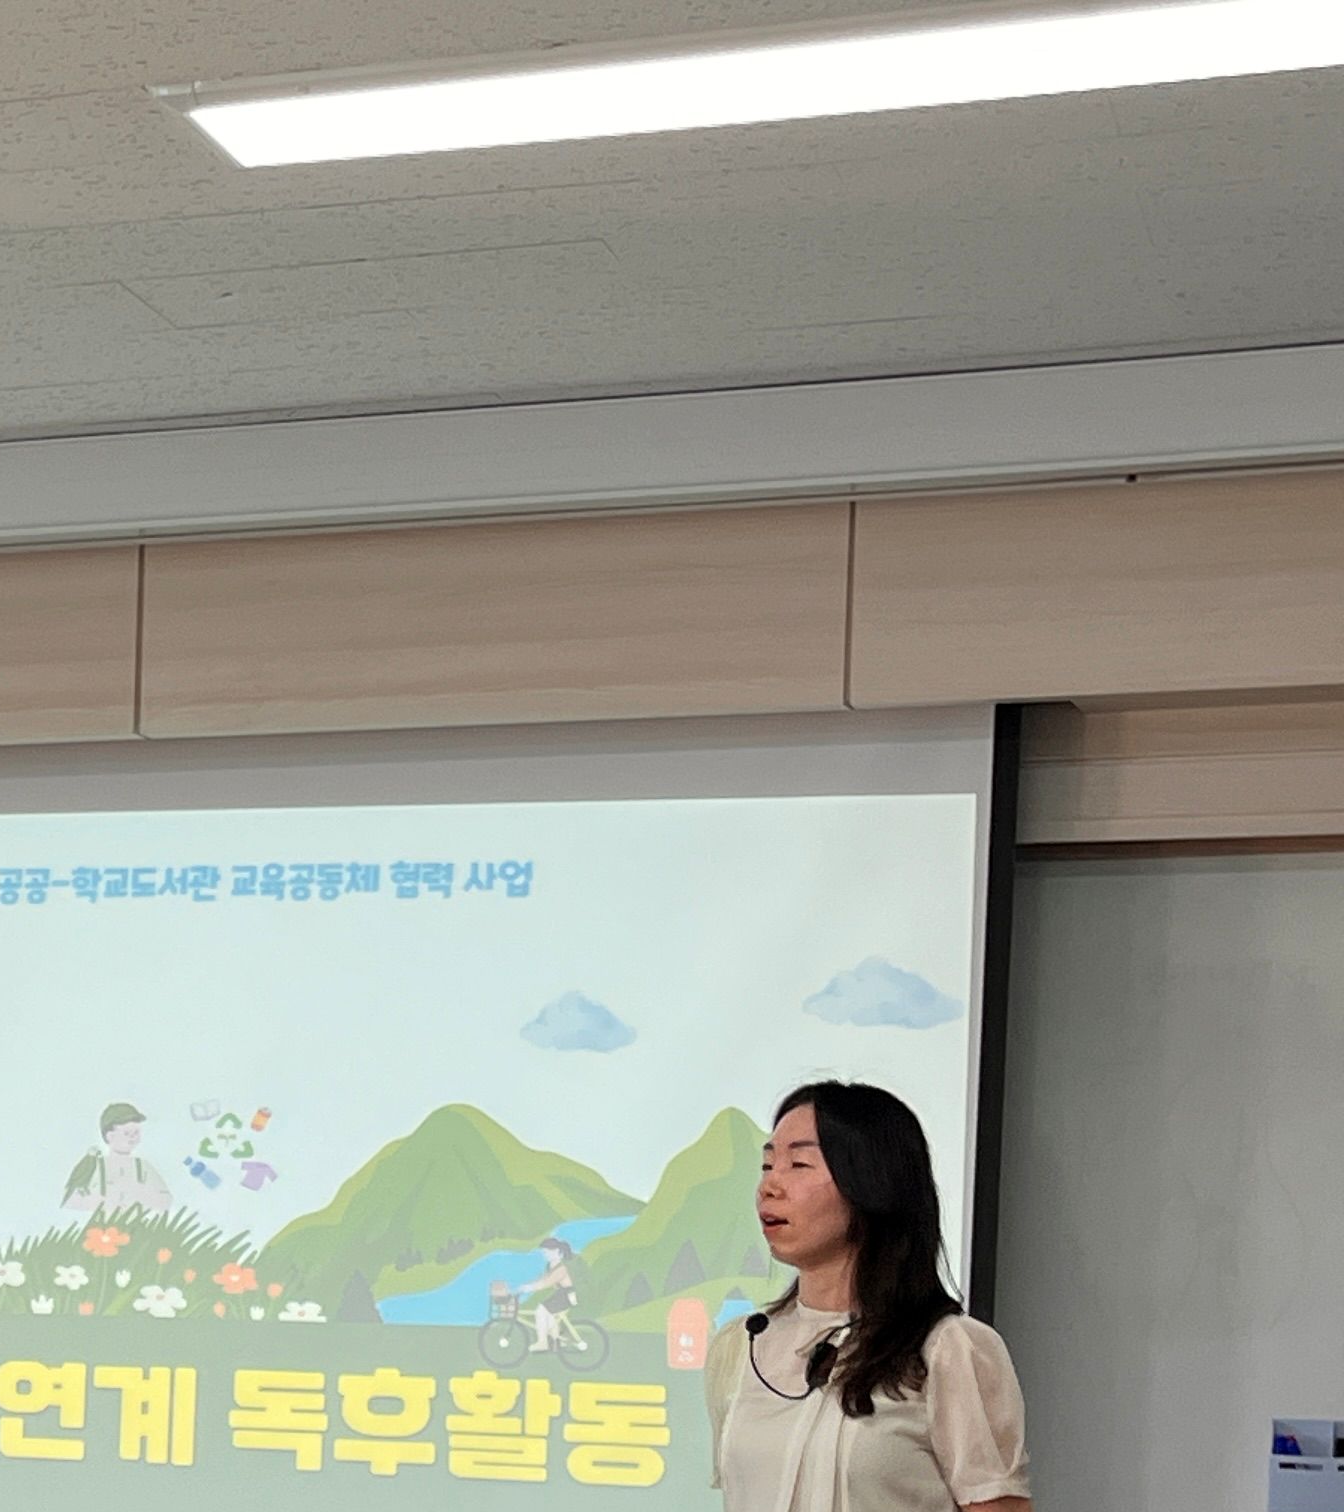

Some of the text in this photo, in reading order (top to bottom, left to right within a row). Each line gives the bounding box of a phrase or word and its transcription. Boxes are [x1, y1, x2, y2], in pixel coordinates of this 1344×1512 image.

[230, 862, 381, 901] 교육공동체
[389, 860, 454, 898] 협력
[463, 860, 534, 898] 사업
[228, 1368, 671, 1487] 독후활동
